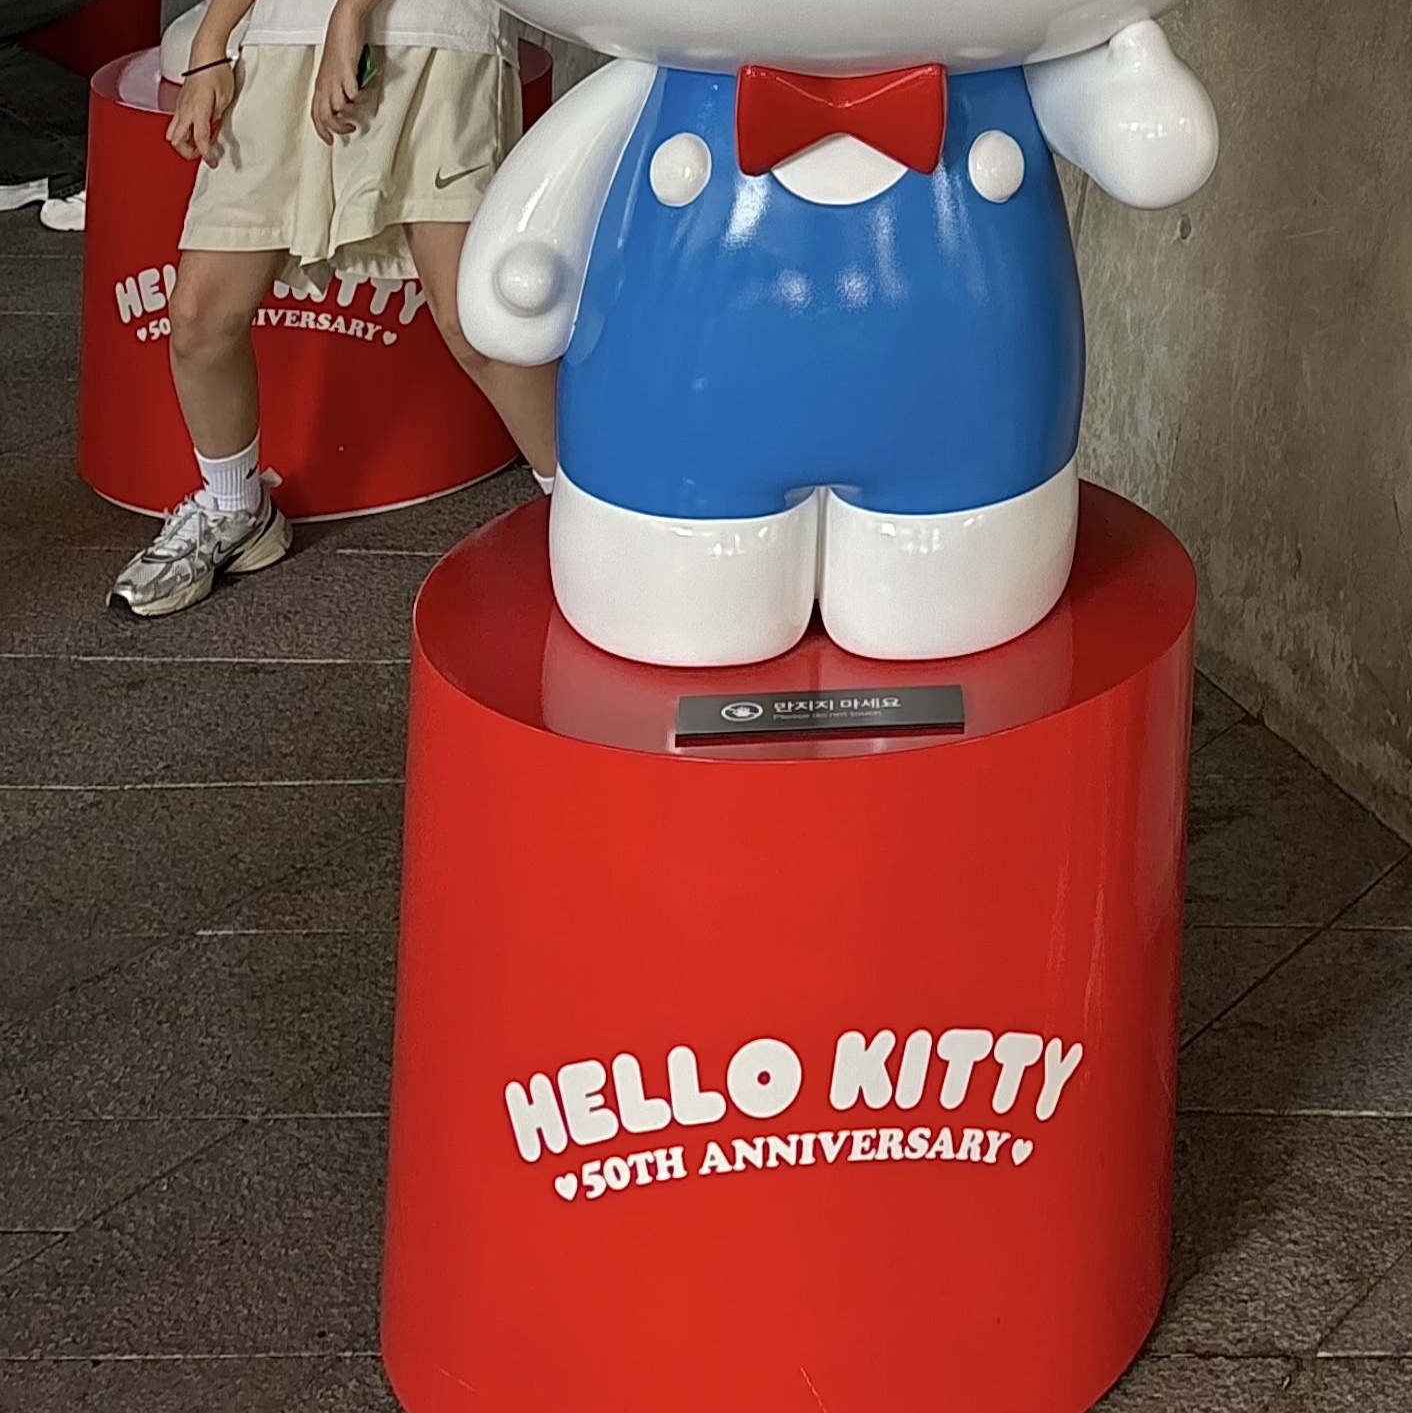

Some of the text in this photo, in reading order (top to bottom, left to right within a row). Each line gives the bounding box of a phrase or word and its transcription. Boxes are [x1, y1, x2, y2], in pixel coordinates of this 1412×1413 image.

[147, 308, 383, 342] 50 IVERSARY
[773, 696, 901, 714] 만지지 마세요
[504, 1028, 1084, 1163] HELLO KITTY
[579, 1126, 1011, 1200] 50TH ANNIVERSARY
